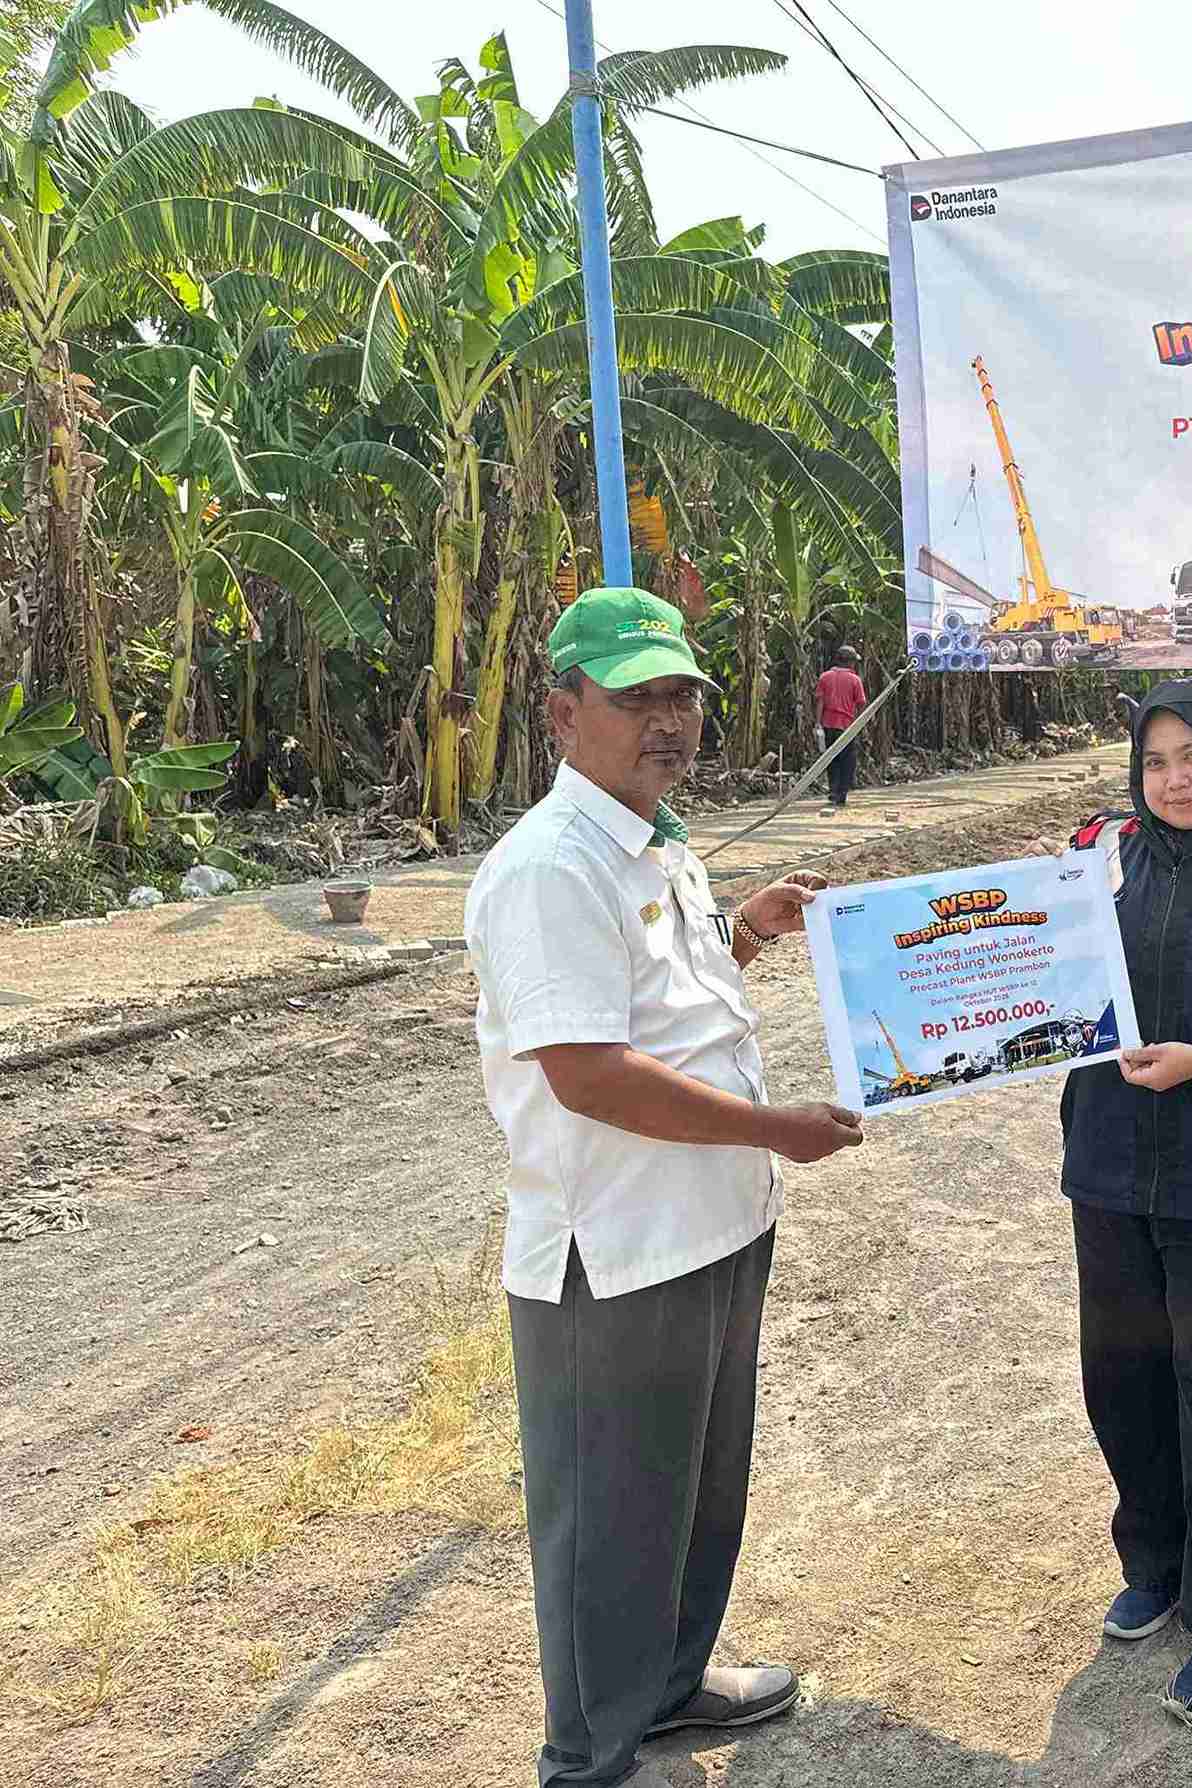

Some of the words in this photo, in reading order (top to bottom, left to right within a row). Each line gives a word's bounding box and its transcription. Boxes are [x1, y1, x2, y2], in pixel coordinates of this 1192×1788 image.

[931, 187, 998, 206] Danantara
[935, 201, 995, 220] Indonesia
[928, 889, 1008, 918] WSBP
[893, 915, 972, 949] Inspiring
[974, 910, 1048, 931] Kindness
[899, 966, 932, 981] Desa
[935, 957, 985, 975] Kedung
[988, 944, 1055, 964] Wonokerto
[916, 948, 960, 964] Paving
[964, 940, 1000, 955] untuk
[1003, 934, 1036, 948] Jalan
[950, 974, 976, 986] Plant
[921, 1022, 948, 1040] Rp
[951, 1000, 1056, 1033] 12.500.000,-
